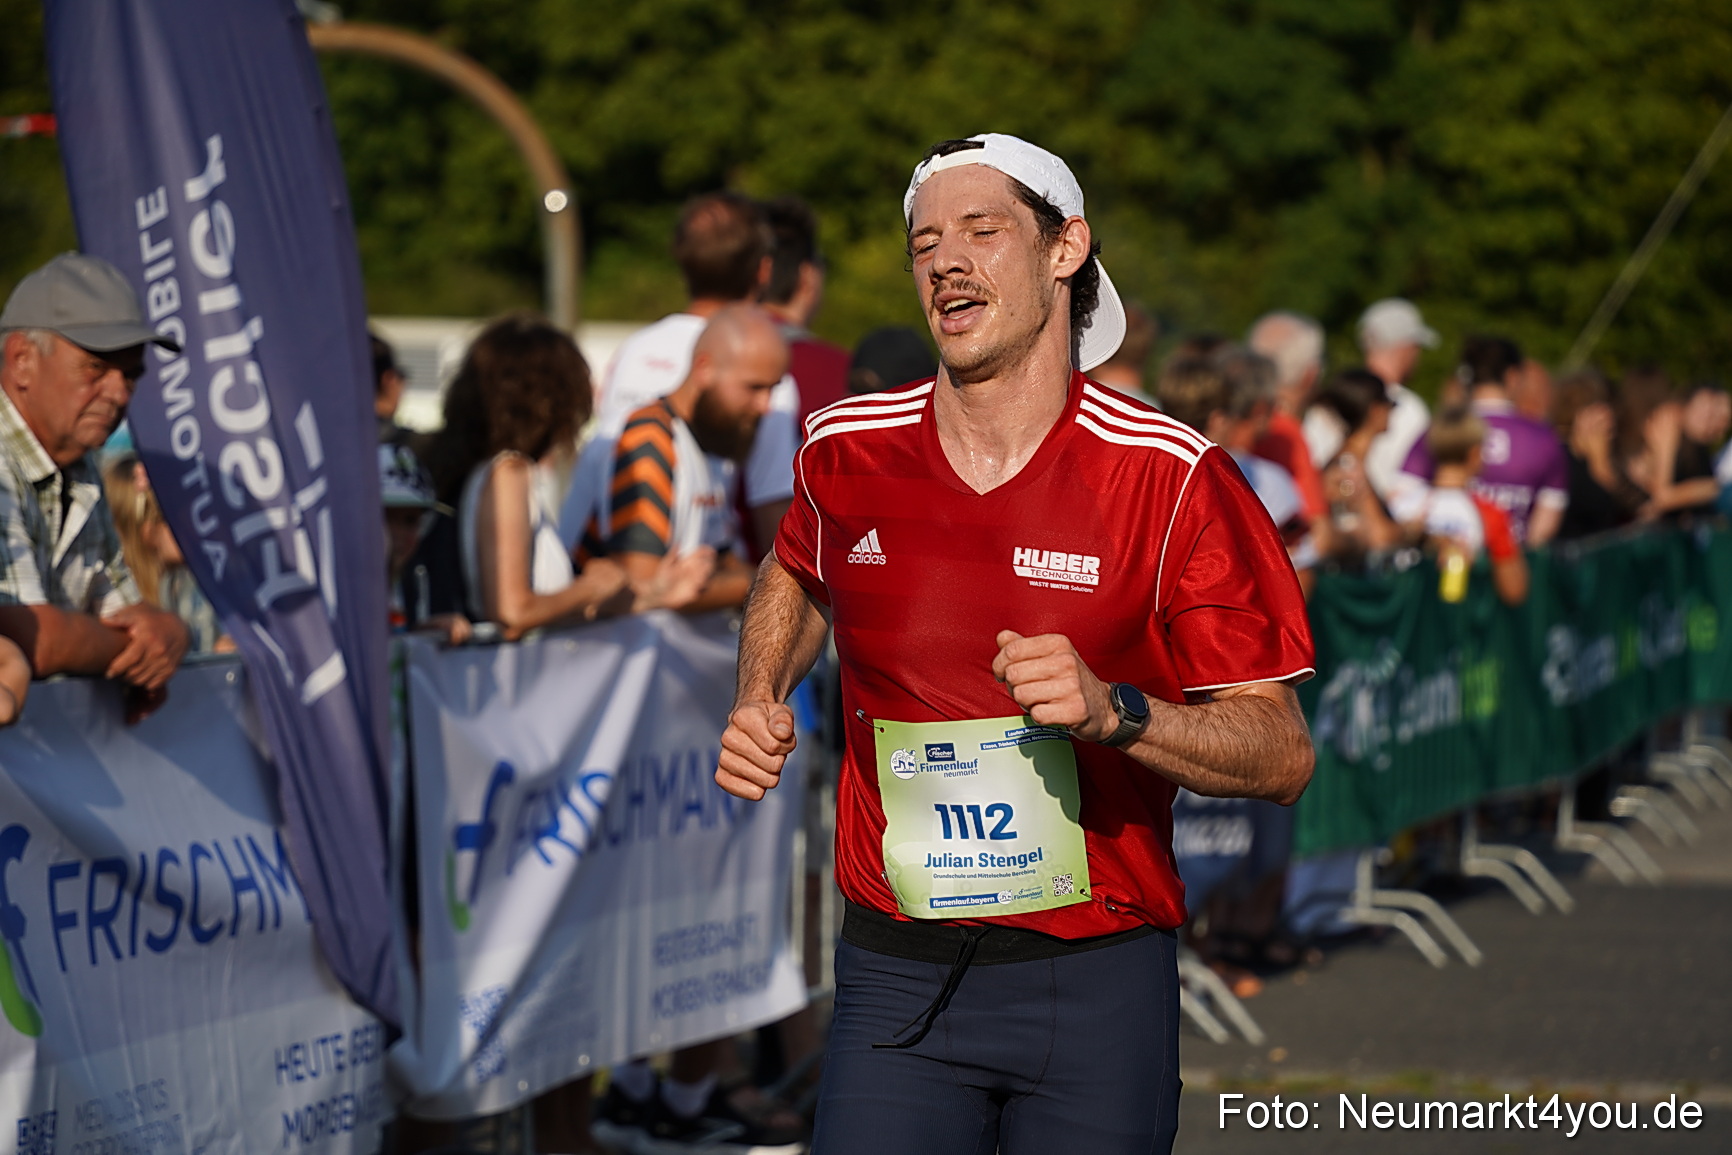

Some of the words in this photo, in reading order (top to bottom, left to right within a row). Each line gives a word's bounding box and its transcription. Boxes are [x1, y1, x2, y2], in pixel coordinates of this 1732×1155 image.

[848, 552, 886, 565] adidas
[1013, 547, 1100, 575] HUBER
[1030, 569, 1095, 582] TECHNOLOGY
[1070, 585, 1094, 593] Solutions
[920, 759, 978, 772] Firmenlauf
[943, 769, 979, 778] neumarkt
[934, 803, 1018, 840] 1112
[924, 853, 974, 868] Julian
[978, 847, 1043, 868] Stengel
[1012, 868, 1036, 877] Berching
[933, 897, 995, 907] firmenlauf.bayern
